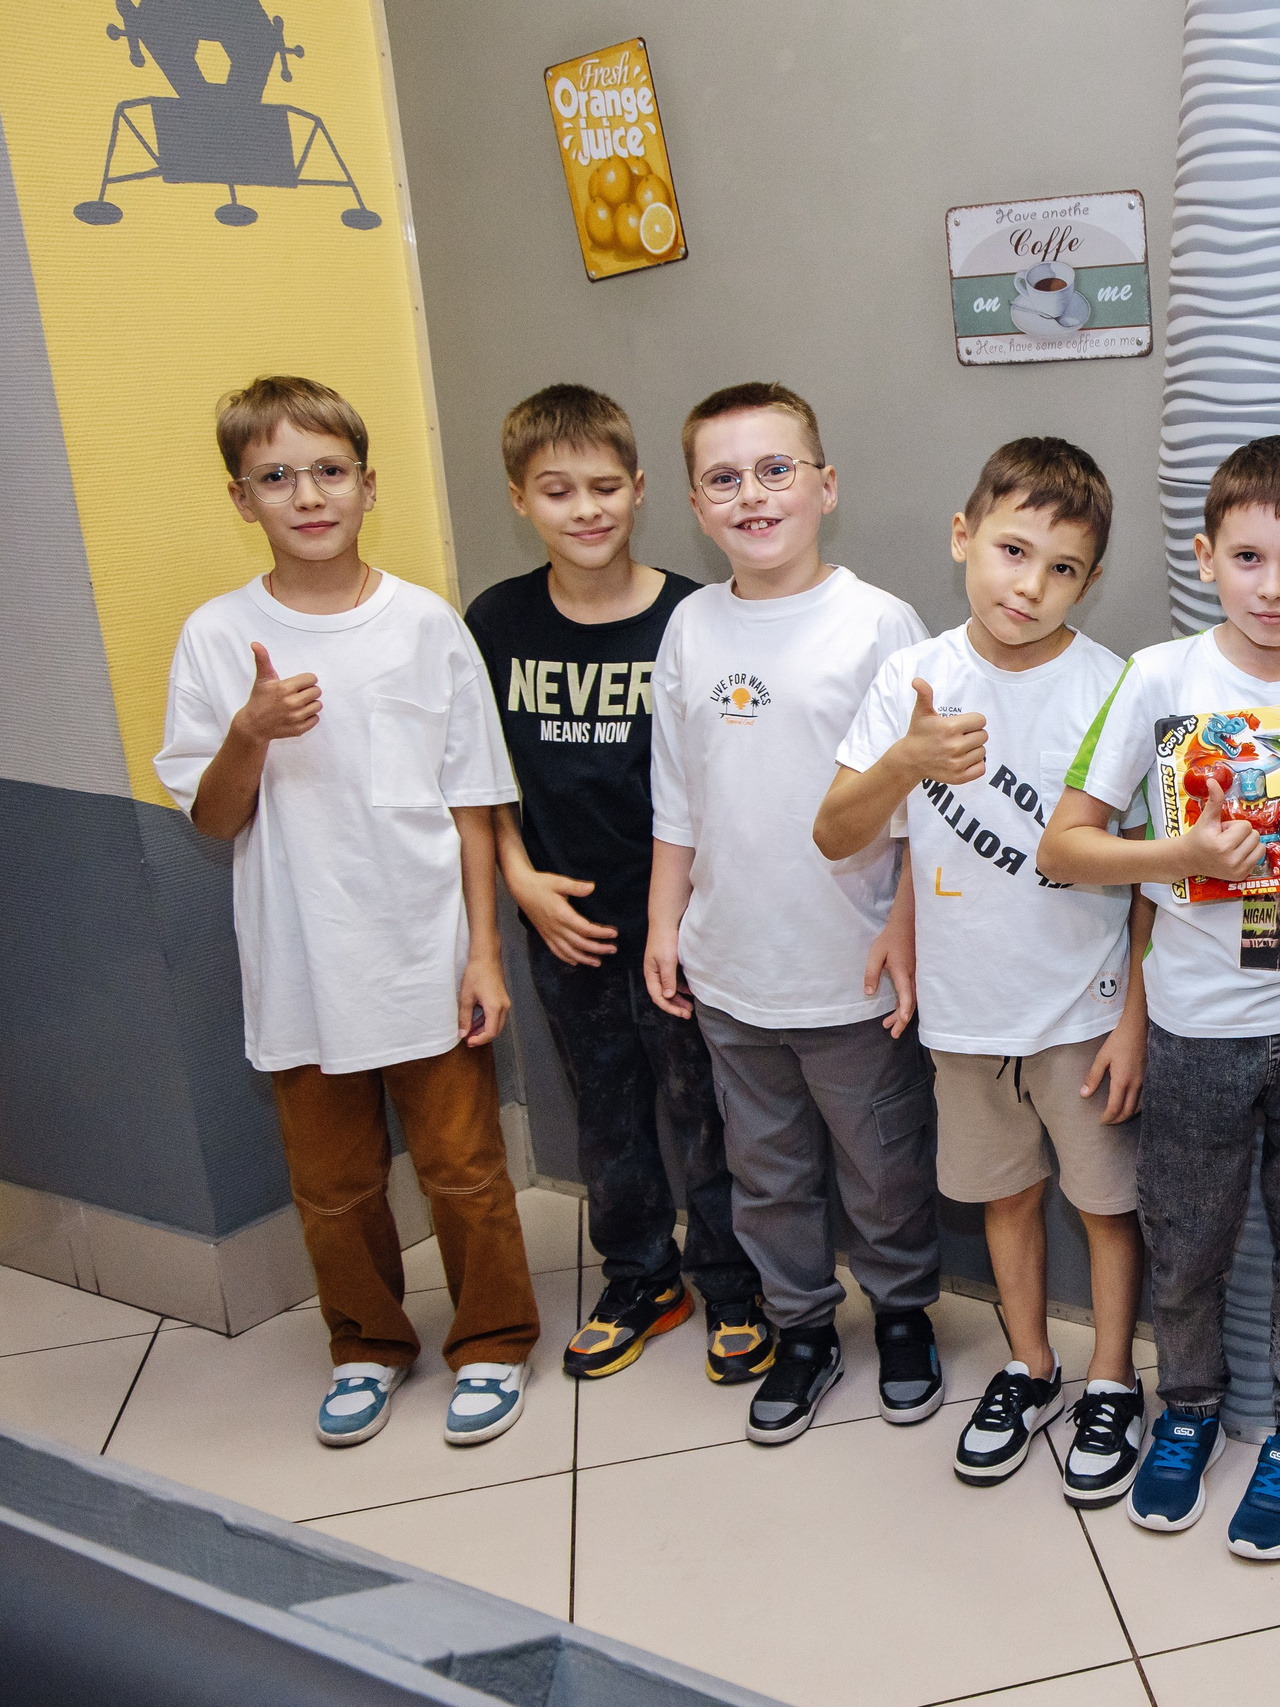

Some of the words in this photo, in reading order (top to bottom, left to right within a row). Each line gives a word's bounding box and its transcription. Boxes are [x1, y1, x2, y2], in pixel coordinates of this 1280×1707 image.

[579, 51, 630, 90] Fresh
[554, 77, 655, 123] Orange
[578, 117, 646, 166] juice
[995, 207, 1037, 224] Have
[1041, 202, 1089, 219] anothe
[1009, 225, 1085, 262] Coffe
[973, 296, 1001, 313] on
[1097, 284, 1133, 302] me
[976, 339, 1007, 355] Here,
[1009, 338, 1032, 353] have
[1035, 340, 1062, 352] some
[1066, 334, 1100, 354] coffee
[1103, 338, 1116, 348] on
[710, 680, 728, 702] LIVE
[728, 673, 746, 686] FOR
[748, 674, 771, 706] WAVES
[540, 719, 590, 743] MEANS
[593, 721, 631, 743] NOW
[1161, 764, 1180, 838] STRIKERS
[1241, 886, 1277, 896] TYRO
[1173, 1426, 1195, 1437] GSD
